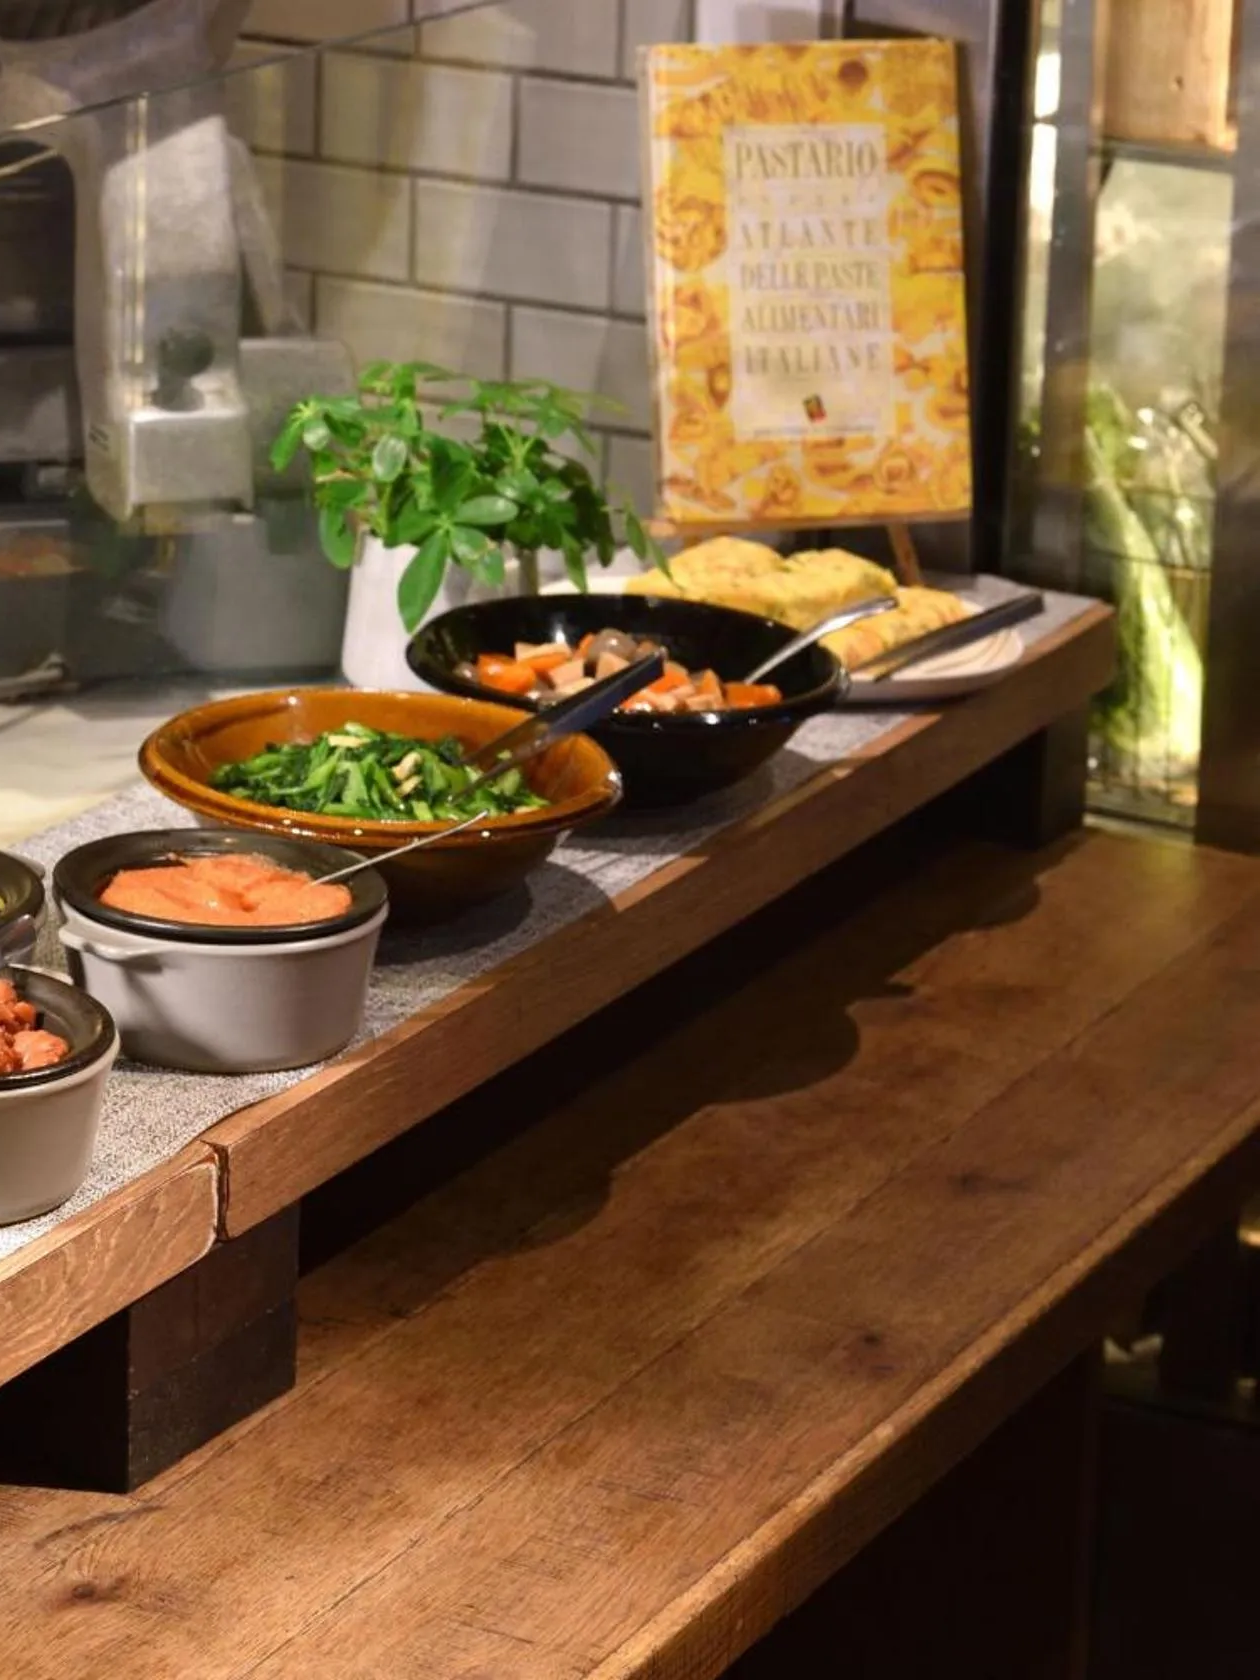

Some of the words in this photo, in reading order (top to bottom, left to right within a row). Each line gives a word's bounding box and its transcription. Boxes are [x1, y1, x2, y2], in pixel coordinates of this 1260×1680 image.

[736, 141, 878, 178] PASTARIO
[740, 220, 877, 249] ATLANTE
[813, 260, 878, 288] PASTE
[742, 302, 880, 332] ALIMENTARI
[745, 343, 880, 375] ITALIANE
